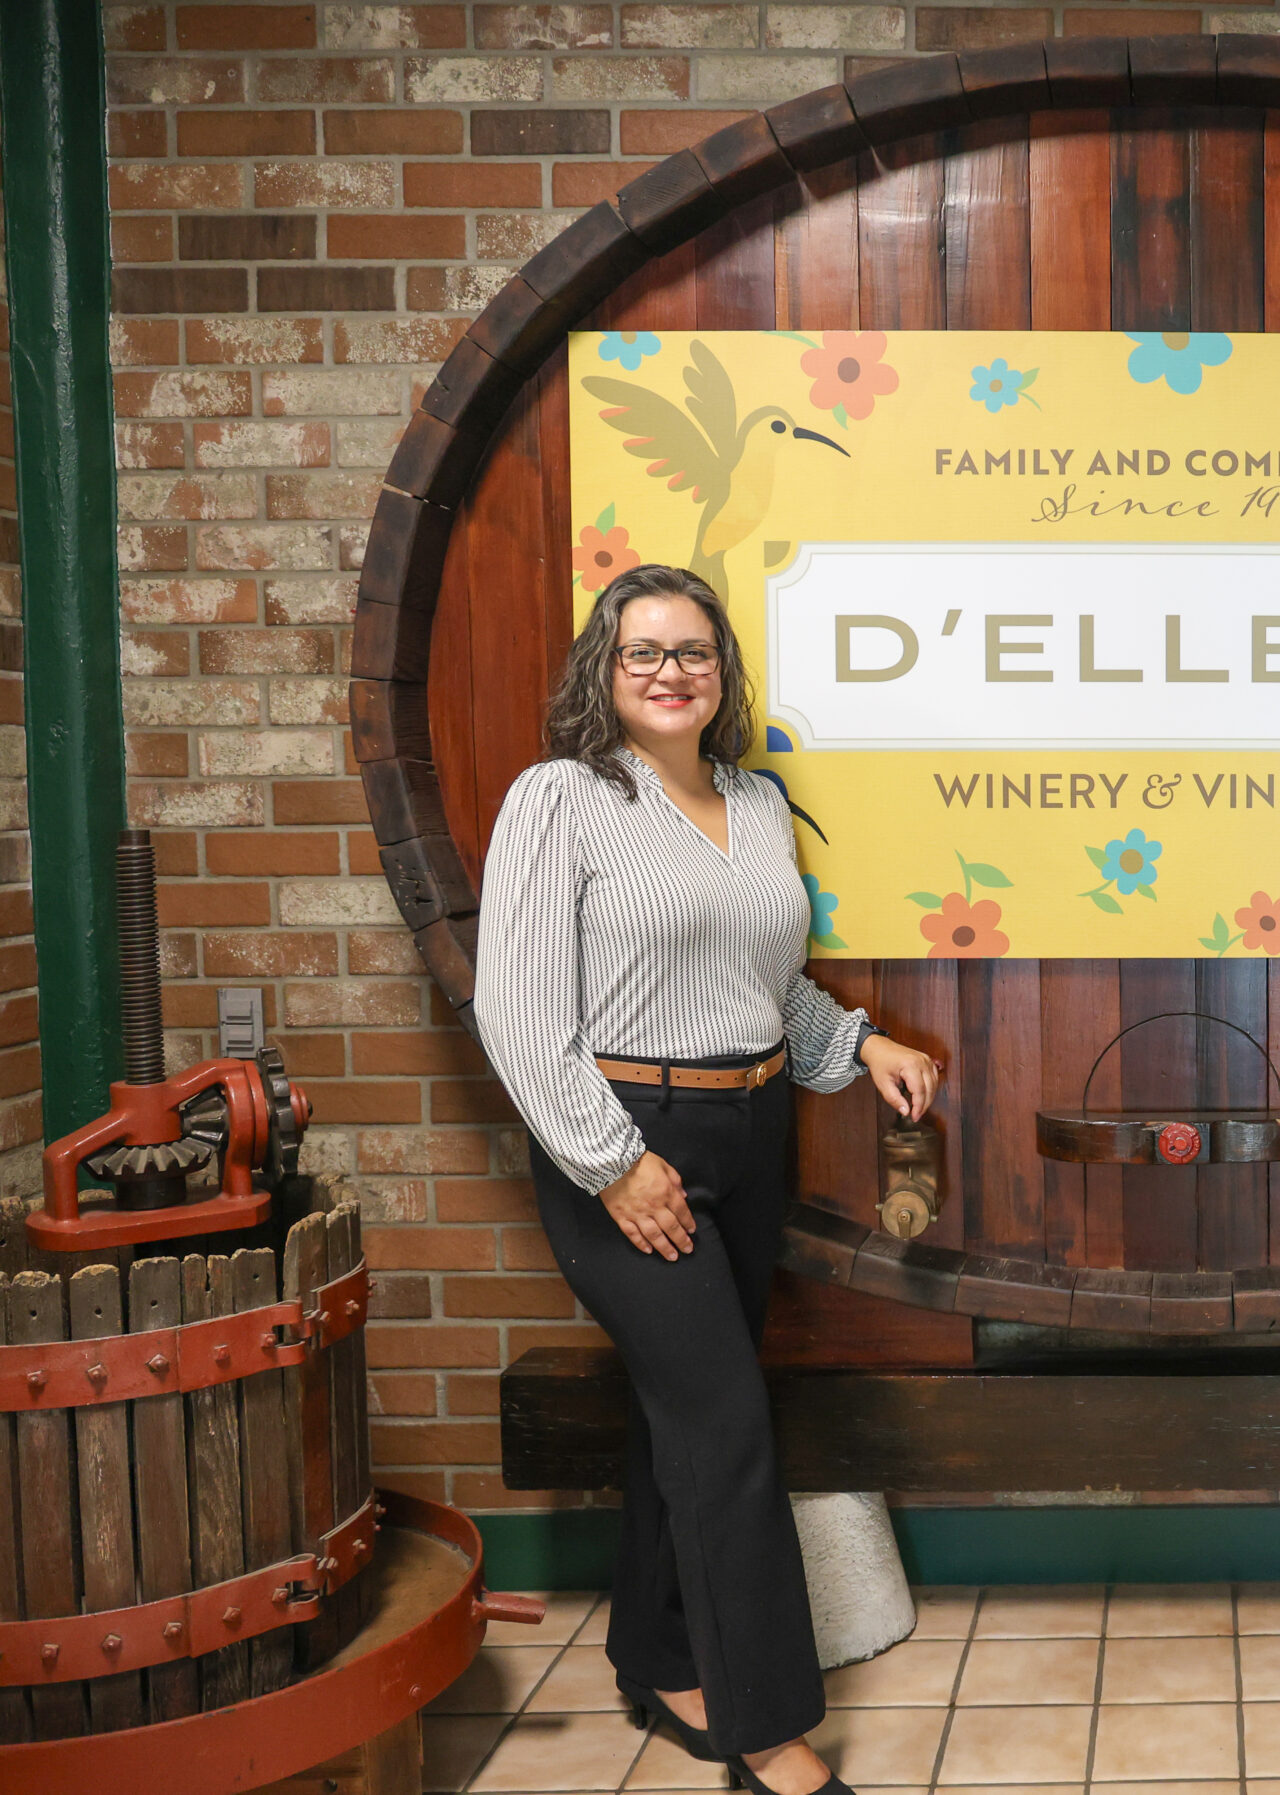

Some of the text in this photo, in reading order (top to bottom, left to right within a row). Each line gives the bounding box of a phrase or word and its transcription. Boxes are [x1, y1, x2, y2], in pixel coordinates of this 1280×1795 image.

[935, 449, 1074, 475] FAMILY
[1086, 450, 1171, 476] AND
[1031, 484, 1219, 522] Since
[933, 773, 1129, 809] WINERY
[1142, 773, 1182, 810] &
